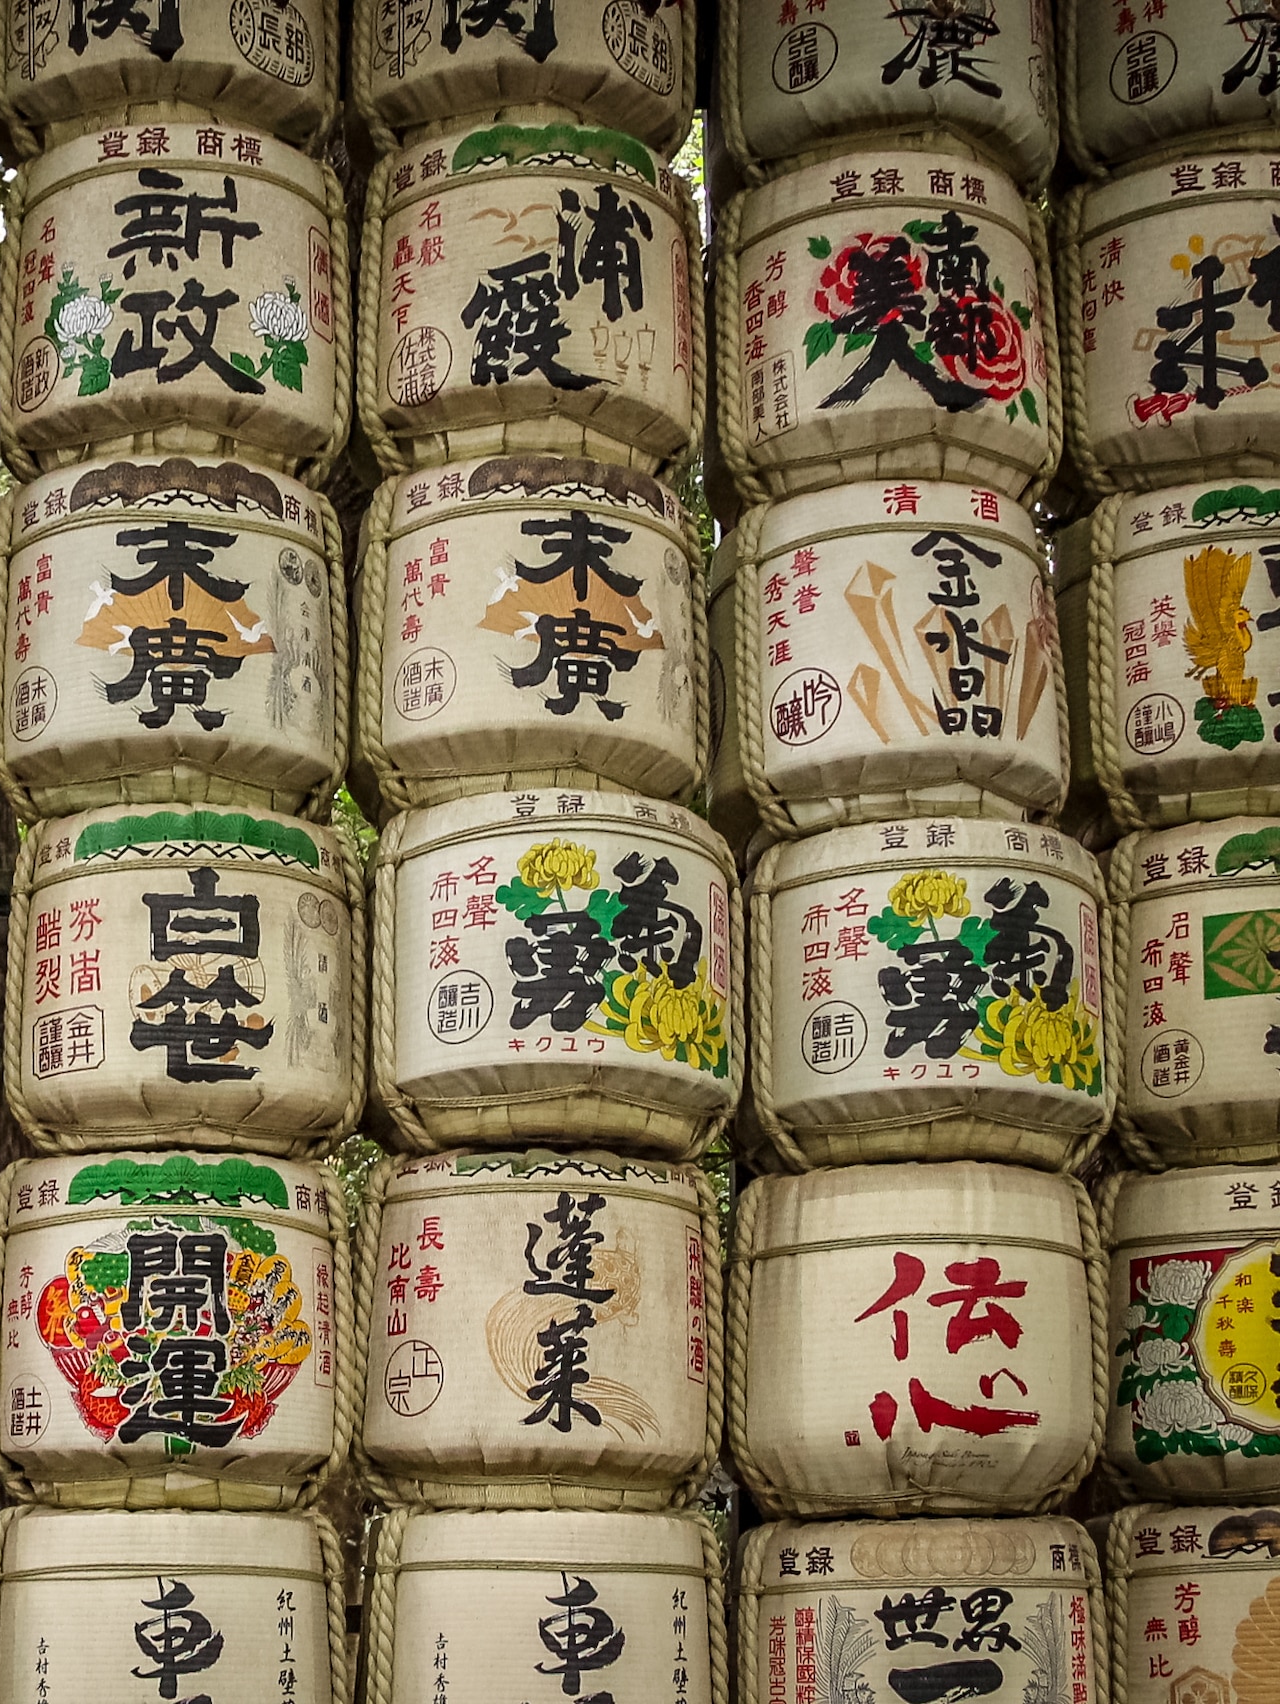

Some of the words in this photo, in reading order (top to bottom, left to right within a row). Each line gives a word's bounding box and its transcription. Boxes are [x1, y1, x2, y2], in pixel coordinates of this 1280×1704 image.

[393, 149, 448, 197] 登録
[107, 168, 266, 394] 新政
[461, 183, 654, 391] 浦霞
[766, 250, 788, 320] 芳醇
[815, 237, 996, 413] 美人
[397, 335, 420, 406] 佐浦
[418, 328, 437, 399] 株式会社
[771, 358, 790, 429] 株式会社
[21, 487, 68, 533] 登録
[406, 472, 466, 514] 登録
[883, 485, 1001, 522] 清酒
[1130, 502, 1187, 536] 登録
[34, 553, 54, 618] 富貴
[427, 537, 451, 598] 富貴
[762, 572, 793, 667] 秀天涯
[911, 530, 1012, 738] 金水晶
[1122, 619, 1152, 688] 冠四海
[15, 680, 30, 733] 酒造
[403, 660, 422, 712] 酒造
[1154, 700, 1175, 743] 小嶋
[462, 855, 498, 931] 名聲
[1140, 846, 1211, 886] 登録
[834, 888, 870, 962] 名聲
[35, 908, 62, 1005] 酷烈
[129, 867, 275, 1084] 白笹
[458, 982, 481, 1030] 吉川
[833, 1012, 856, 1059] 吉川
[67, 1011, 96, 1067] 金井
[508, 1037, 606, 1053] キクユウ
[1153, 1044, 1170, 1088] 酒造
[1173, 1038, 1190, 1084] 黄金井
[882, 1064, 981, 1081] キクユウ
[16, 1179, 60, 1214] 登録
[387, 1243, 412, 1337] 比南山
[414, 1216, 444, 1303] 長壽
[7, 1298, 20, 1349] 無比
[1234, 1272, 1255, 1314] 和楽
[118, 1231, 249, 1448] 開運
[854, 1251, 1041, 1442] 伝心
[1215, 1293, 1237, 1360] 千秋壽
[11, 1387, 25, 1436] 酒造
[25, 1386, 42, 1435] 土井
[779, 1546, 835, 1578] 登録
[1134, 1525, 1203, 1559] 登録
[130, 1575, 225, 1704] 車
[1174, 1582, 1201, 1646] 芳醇
[35, 1637, 51, 1704] 吉村秀
[1144, 1616, 1174, 1680] 無比
